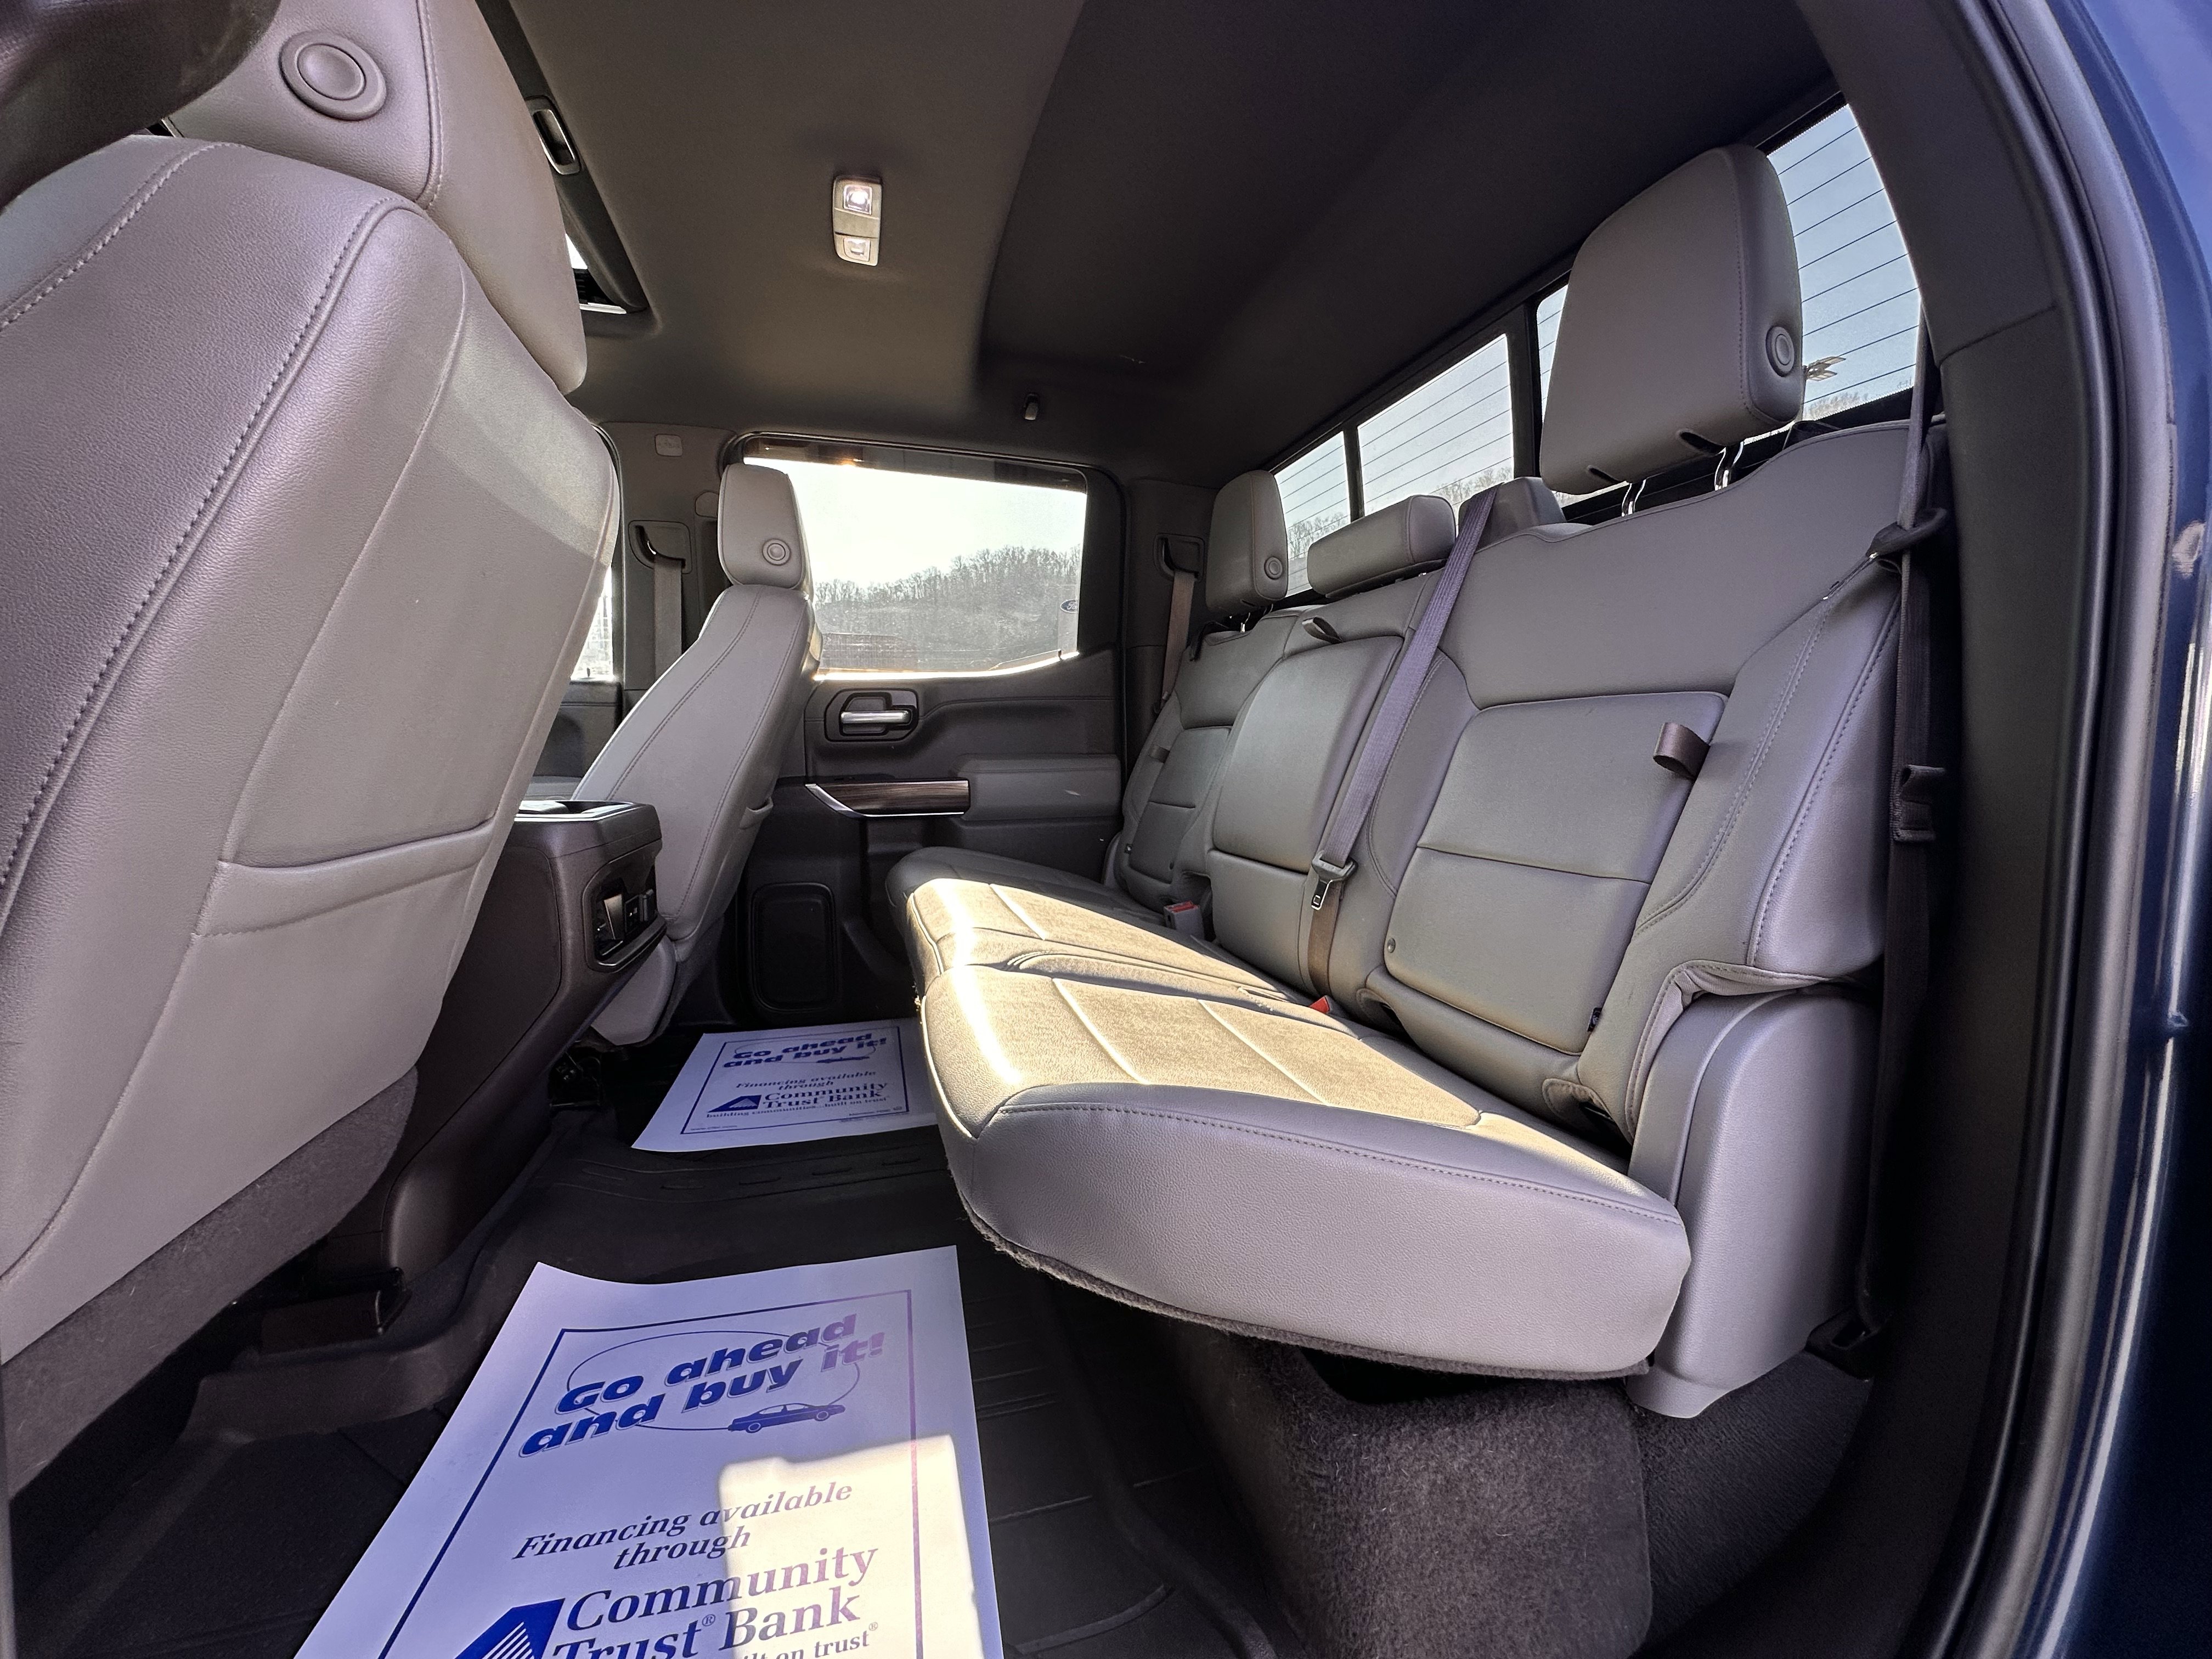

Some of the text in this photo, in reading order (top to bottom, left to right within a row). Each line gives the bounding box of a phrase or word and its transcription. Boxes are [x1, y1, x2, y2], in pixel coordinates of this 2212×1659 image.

[724, 1055, 783, 1068] and
[793, 1046, 847, 1059] buy
[733, 1034, 872, 1059] Go ahead
[736, 1071, 876, 1088] Financing available
[765, 1082, 888, 1101] Community
[778, 1081, 834, 1091] through
[829, 1090, 882, 1102] Bank
[555, 1314, 857, 1415] Go ahead
[518, 1332, 885, 1458] and buy it!
[511, 1481, 852, 1560] Financing available
[613, 1525, 751, 1570] through
[567, 1547, 878, 1630] Community
[718, 1586, 861, 1651] Bank
